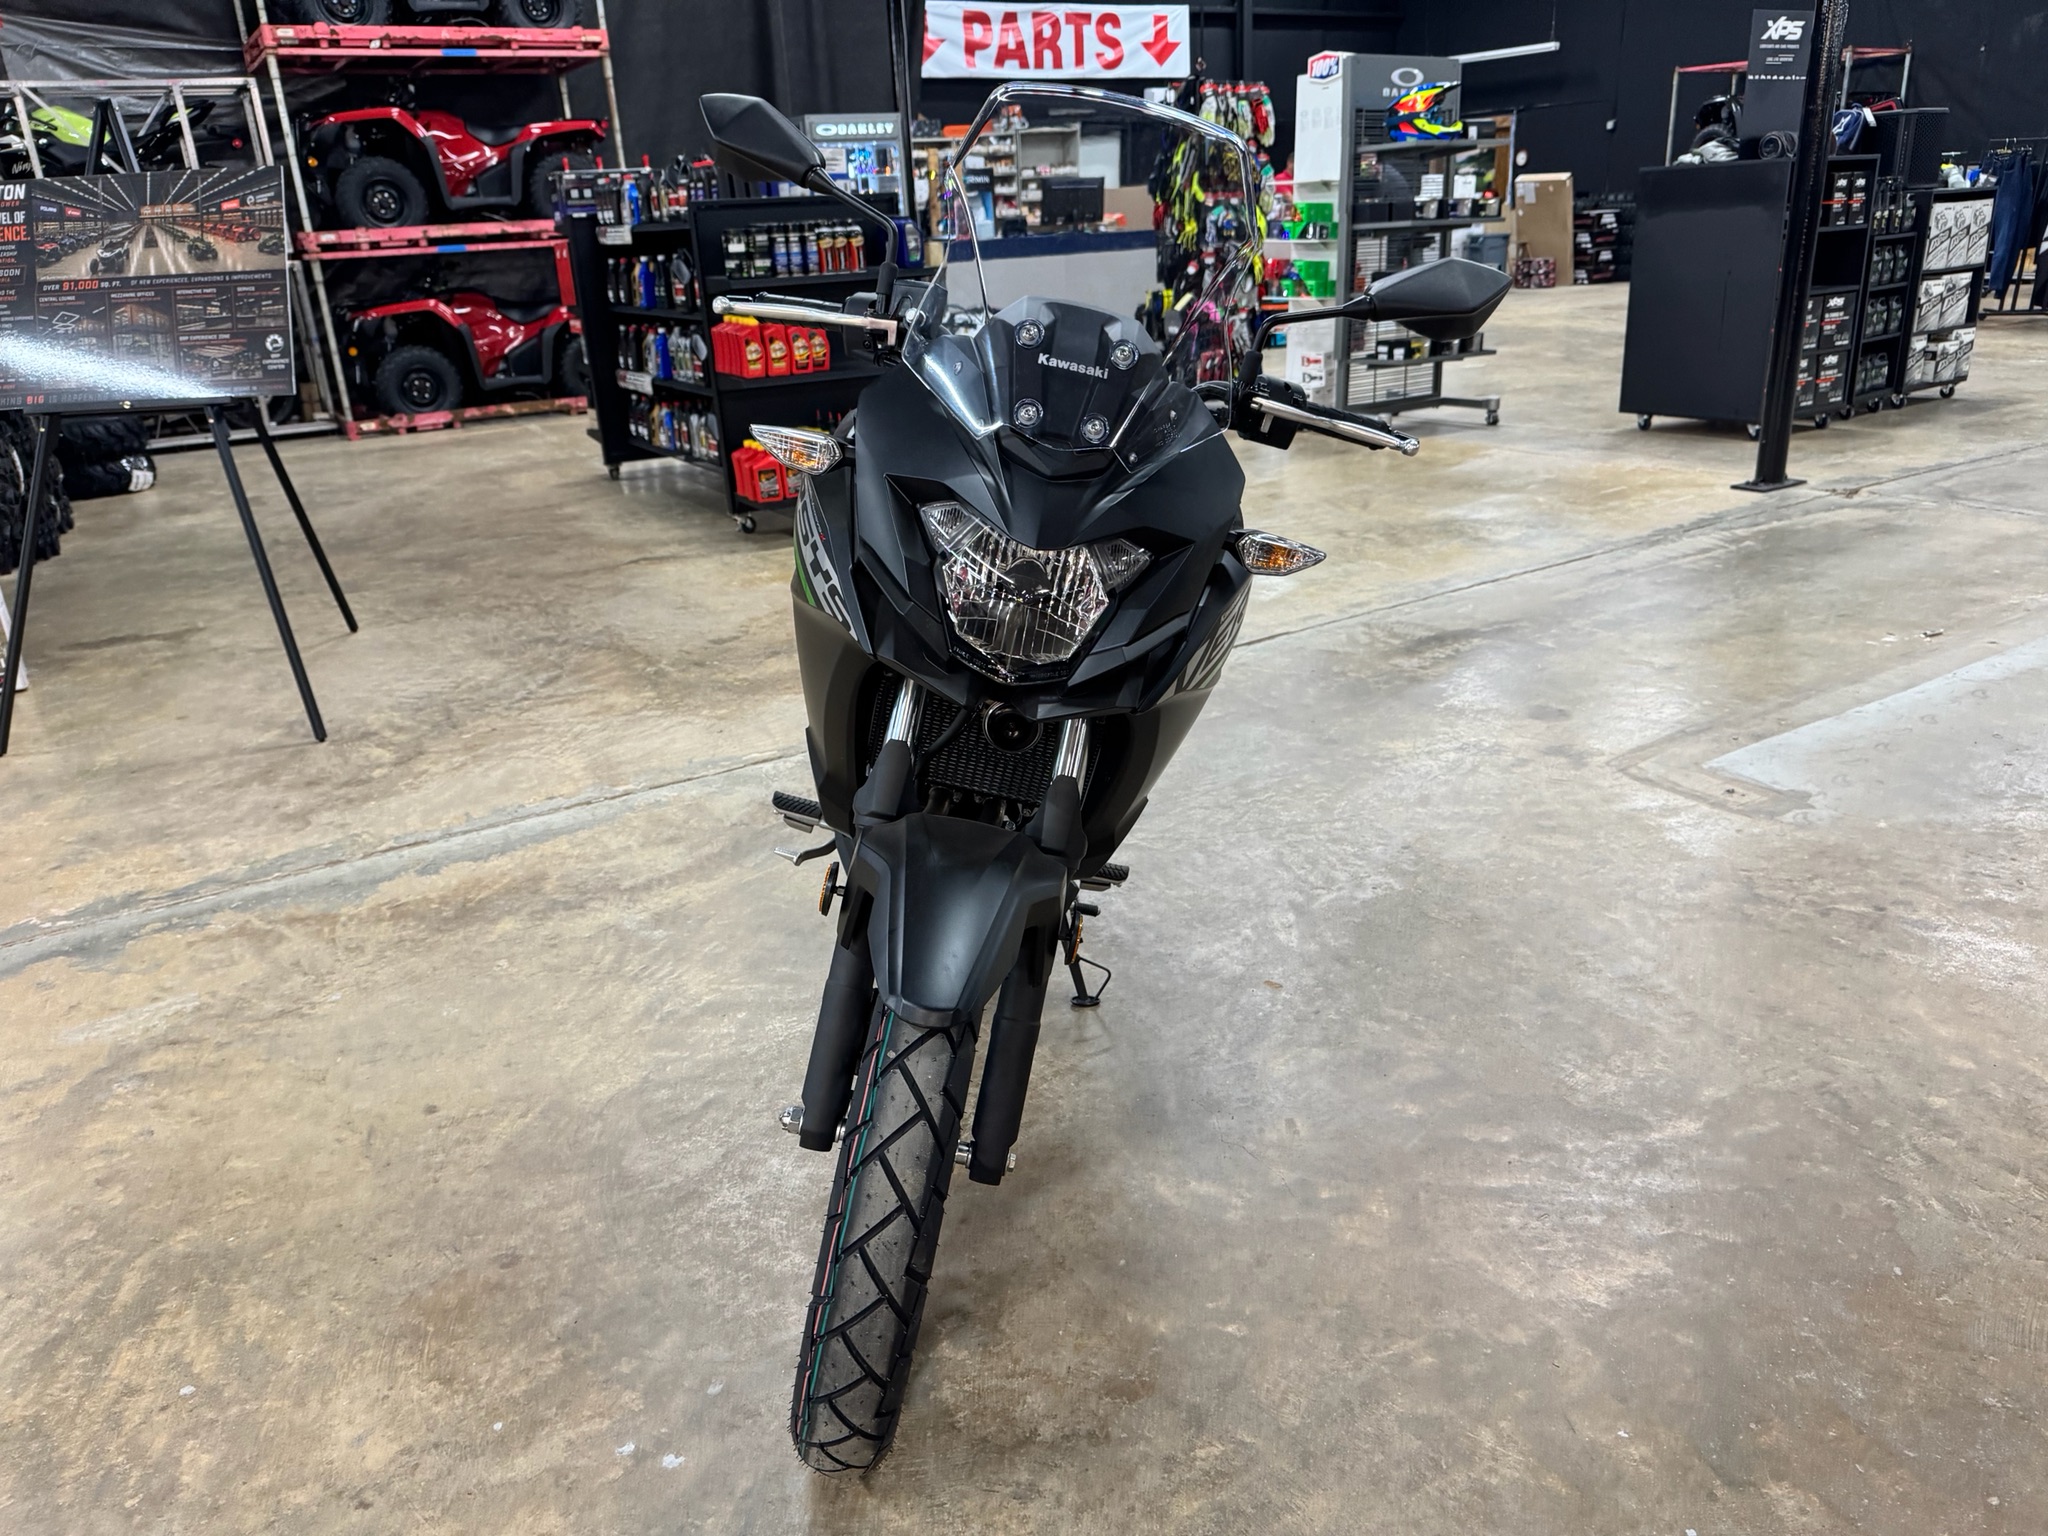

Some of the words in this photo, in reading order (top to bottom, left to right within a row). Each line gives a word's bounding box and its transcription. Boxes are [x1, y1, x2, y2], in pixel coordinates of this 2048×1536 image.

[1760, 16, 1806, 40] XPS
[962, 9, 1125, 71] PARTS
[1311, 56, 1338, 77] 100%
[837, 122, 894, 135] OAKLEY
[14, 211, 26, 224] OF
[0, 225, 31, 241] ENCE.
[62, 280, 99, 292] 91,000
[1037, 353, 1109, 379] Kawasaki
[26, 395, 45, 405] BIG
